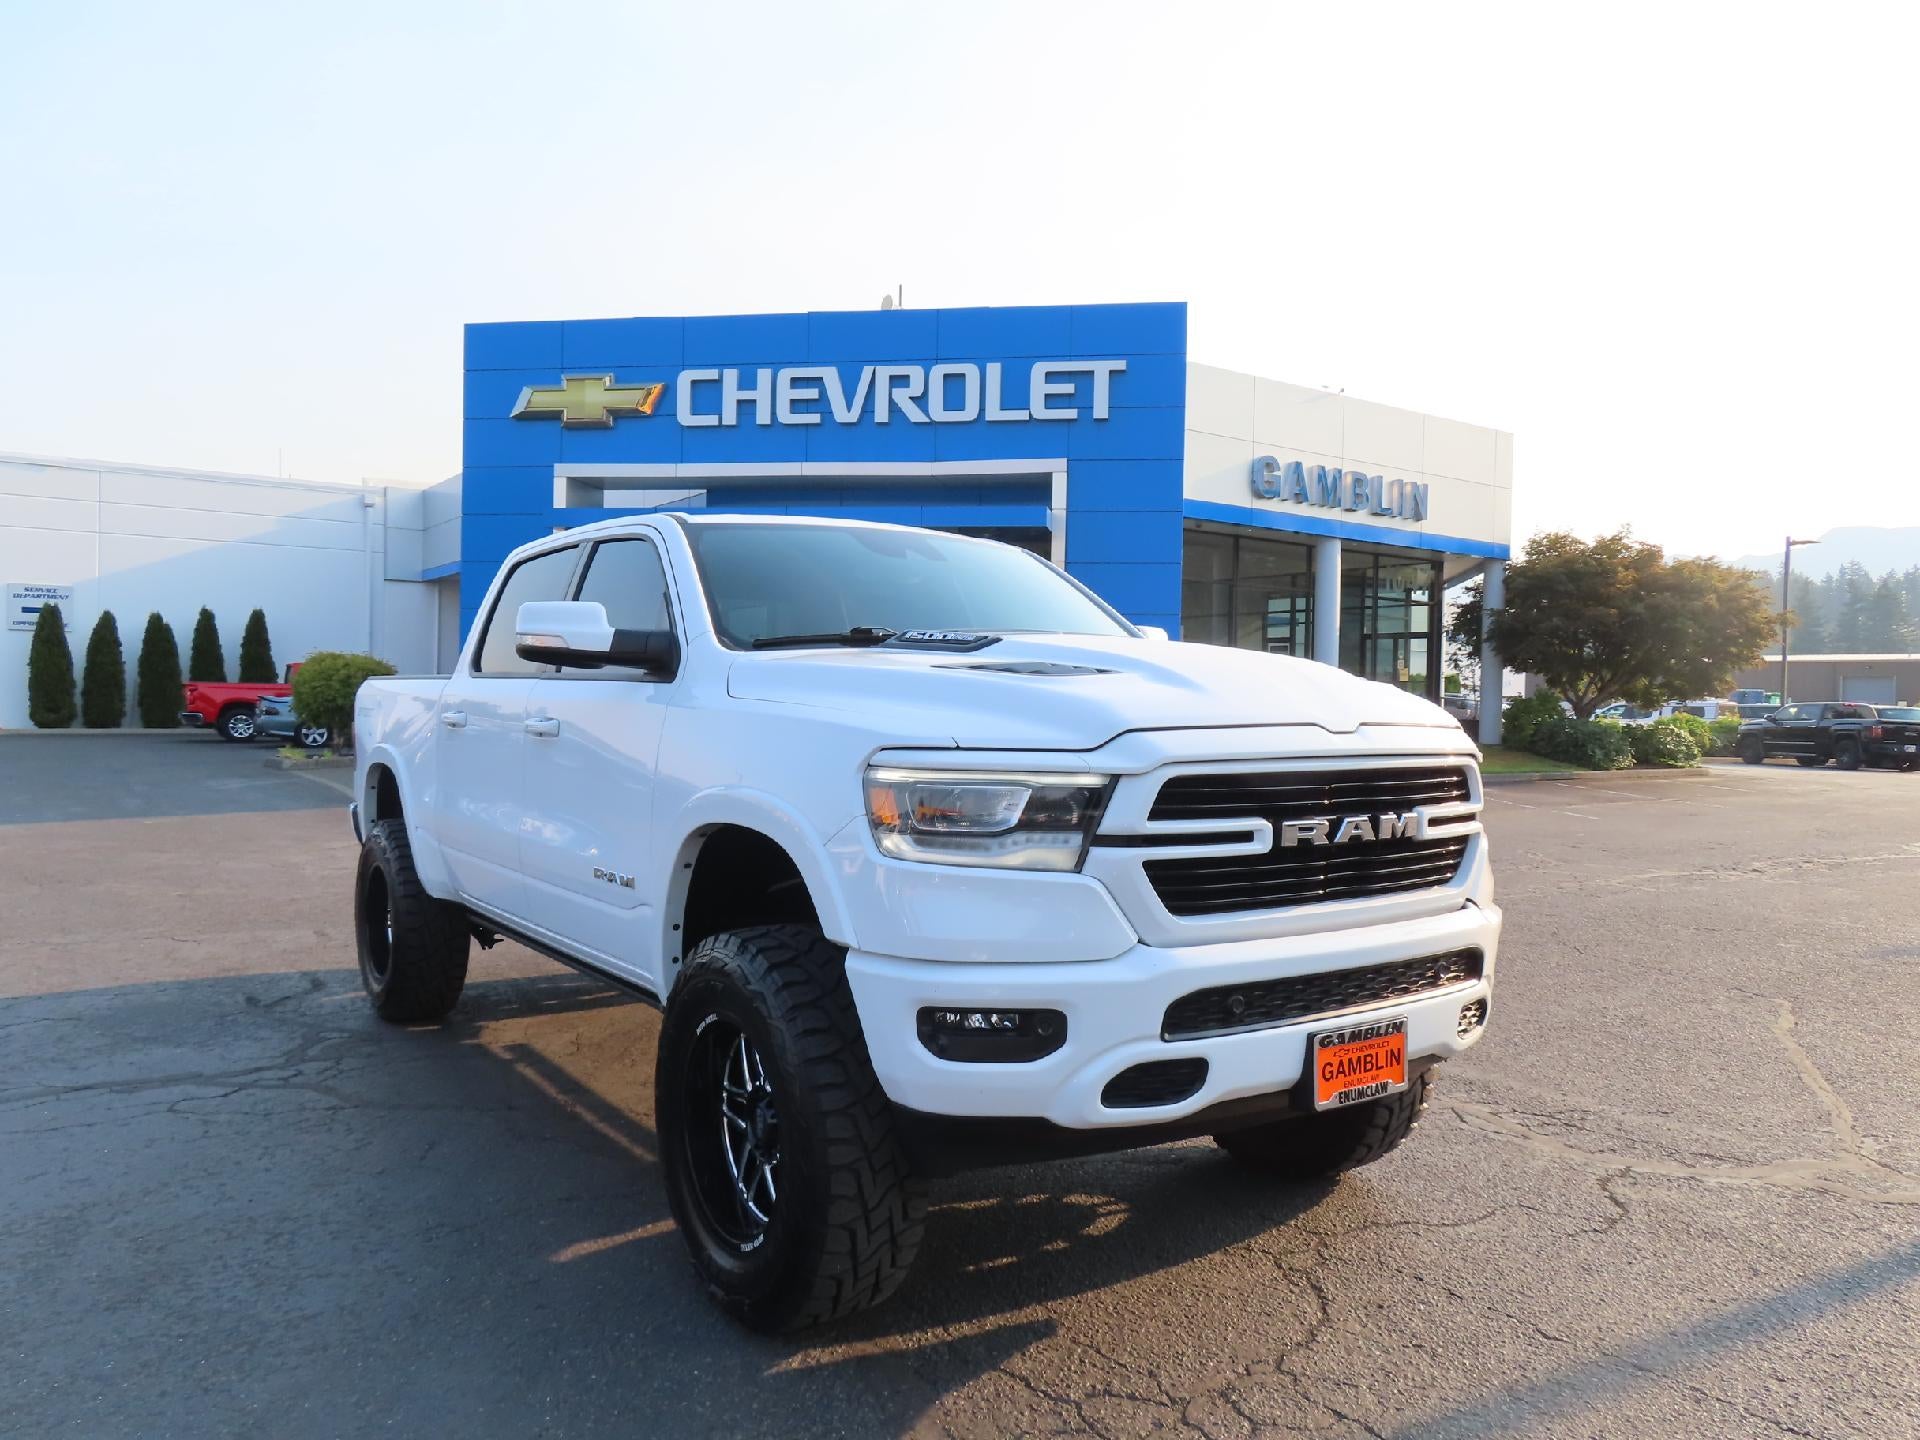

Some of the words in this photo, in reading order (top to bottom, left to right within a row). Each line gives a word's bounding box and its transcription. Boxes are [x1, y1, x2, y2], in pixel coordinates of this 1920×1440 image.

[676, 360, 1127, 427] CHEVROLET
[1252, 455, 1428, 521] GAMBLIN
[12, 592, 69, 600] DEPARTMENT
[1280, 812, 1419, 847] RAM
[593, 866, 636, 889] RAM
[1319, 1021, 1404, 1048] GAMBLIN
[1351, 1041, 1390, 1054] CHEVROLET
[1321, 1047, 1401, 1082] GAMBLIN
[1338, 1080, 1389, 1104] ENUMCLAW
[1343, 1073, 1380, 1088] ENUMCLAW
